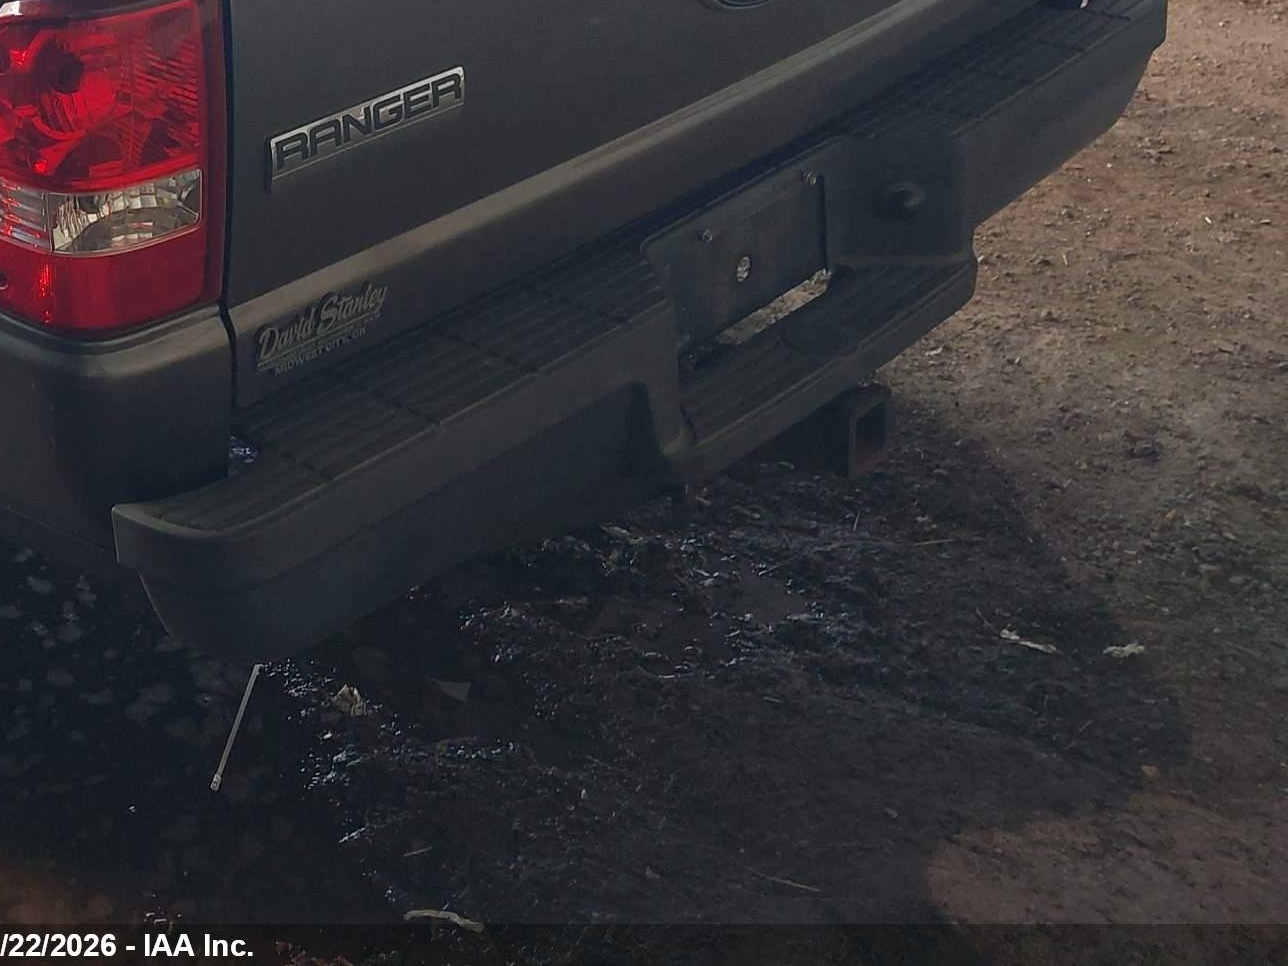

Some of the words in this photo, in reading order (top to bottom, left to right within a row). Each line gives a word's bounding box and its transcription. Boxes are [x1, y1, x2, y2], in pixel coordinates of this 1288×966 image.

[274, 72, 462, 171] RANGER
[259, 307, 317, 360] David
[316, 283, 388, 337] Stanley
